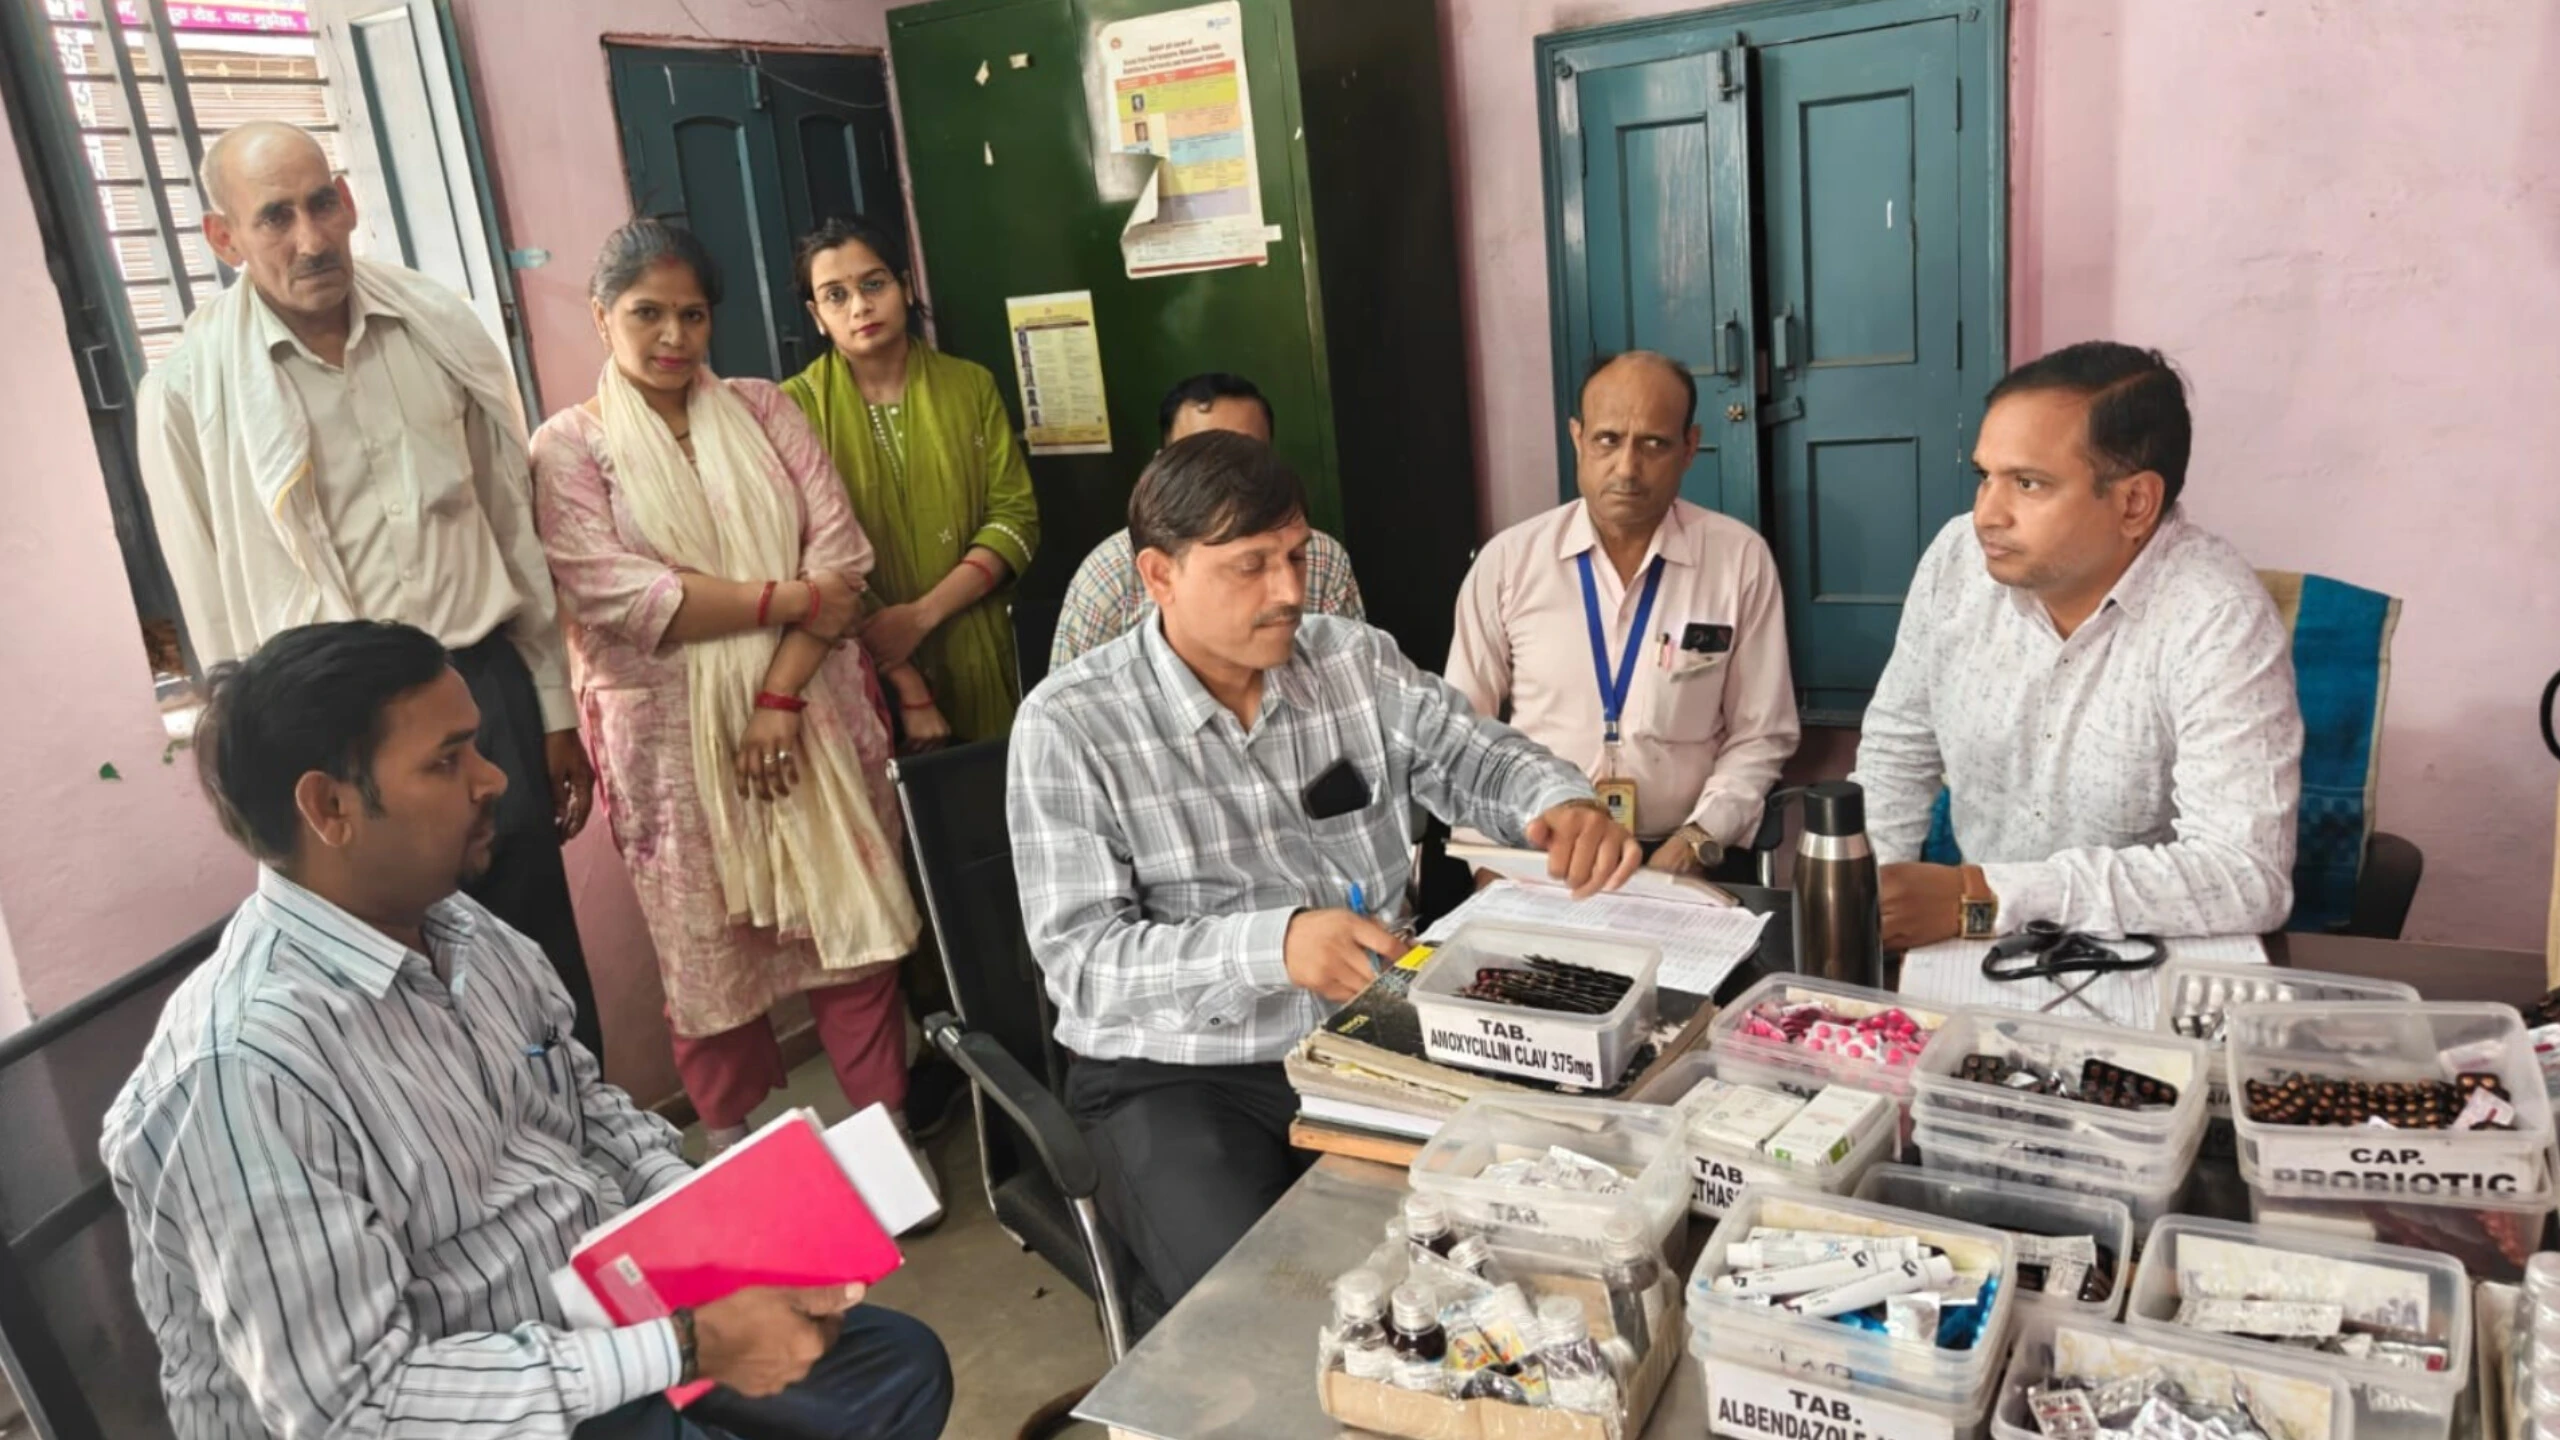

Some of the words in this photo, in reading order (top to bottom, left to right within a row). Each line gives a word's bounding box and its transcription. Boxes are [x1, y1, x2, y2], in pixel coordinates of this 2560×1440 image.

[1478, 1018, 1532, 1042] TAB.
[1430, 1028, 1512, 1063] AMOXYCILLIN
[1514, 1046, 1547, 1069] CLAV
[1551, 1052, 1594, 1082] 375mg
[2350, 1147, 2425, 1165] CAP.
[2273, 1167, 2518, 1198] PROBIOTIC
[1788, 1389, 1863, 1425] TAB.
